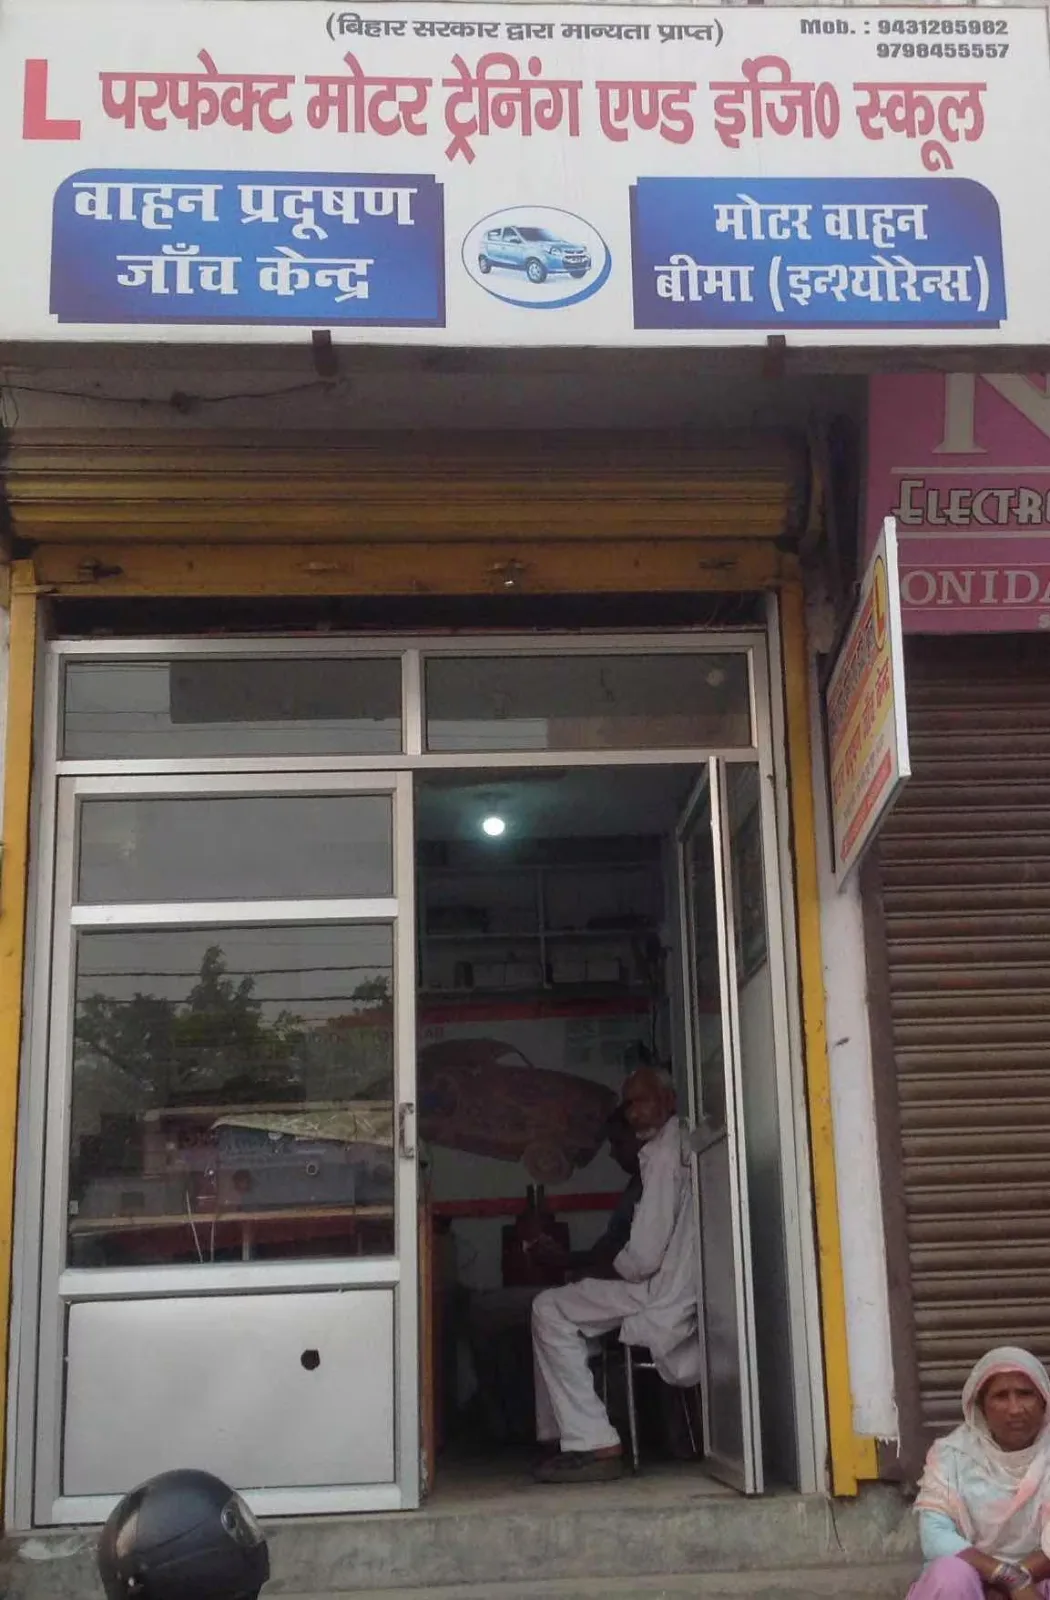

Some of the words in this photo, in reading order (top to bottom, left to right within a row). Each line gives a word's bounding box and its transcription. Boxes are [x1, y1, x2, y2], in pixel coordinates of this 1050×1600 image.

[326, 12, 407, 41] (बिहार
[412, 20, 500, 39] सरकार
[506, 22, 554, 41] द्वारा
[561, 22, 651, 41] मान्यता
[657, 18, 724, 47] प्राप्त)
[799, 18, 856, 35] Mob.
[877, 19, 1009, 35] 9431285982
[876, 42, 1010, 59] 9798455557
[22, 58, 81, 141] L
[98, 48, 295, 136] परफेक्ट
[304, 51, 433, 137] मोटर
[441, 51, 583, 164] ट्रेनिंग
[595, 80, 697, 145] एण्ड
[853, 82, 988, 171] स्कूल
[72, 181, 223, 231] वाहन
[237, 183, 418, 240] प्रदूषण
[713, 193, 813, 242] मोटर
[821, 203, 928, 249] वाहन
[116, 242, 242, 296] जाँच
[255, 246, 375, 304] केन्द्र
[654, 254, 755, 304] बीमा
[890, 479, 1050, 525] ELECTR
